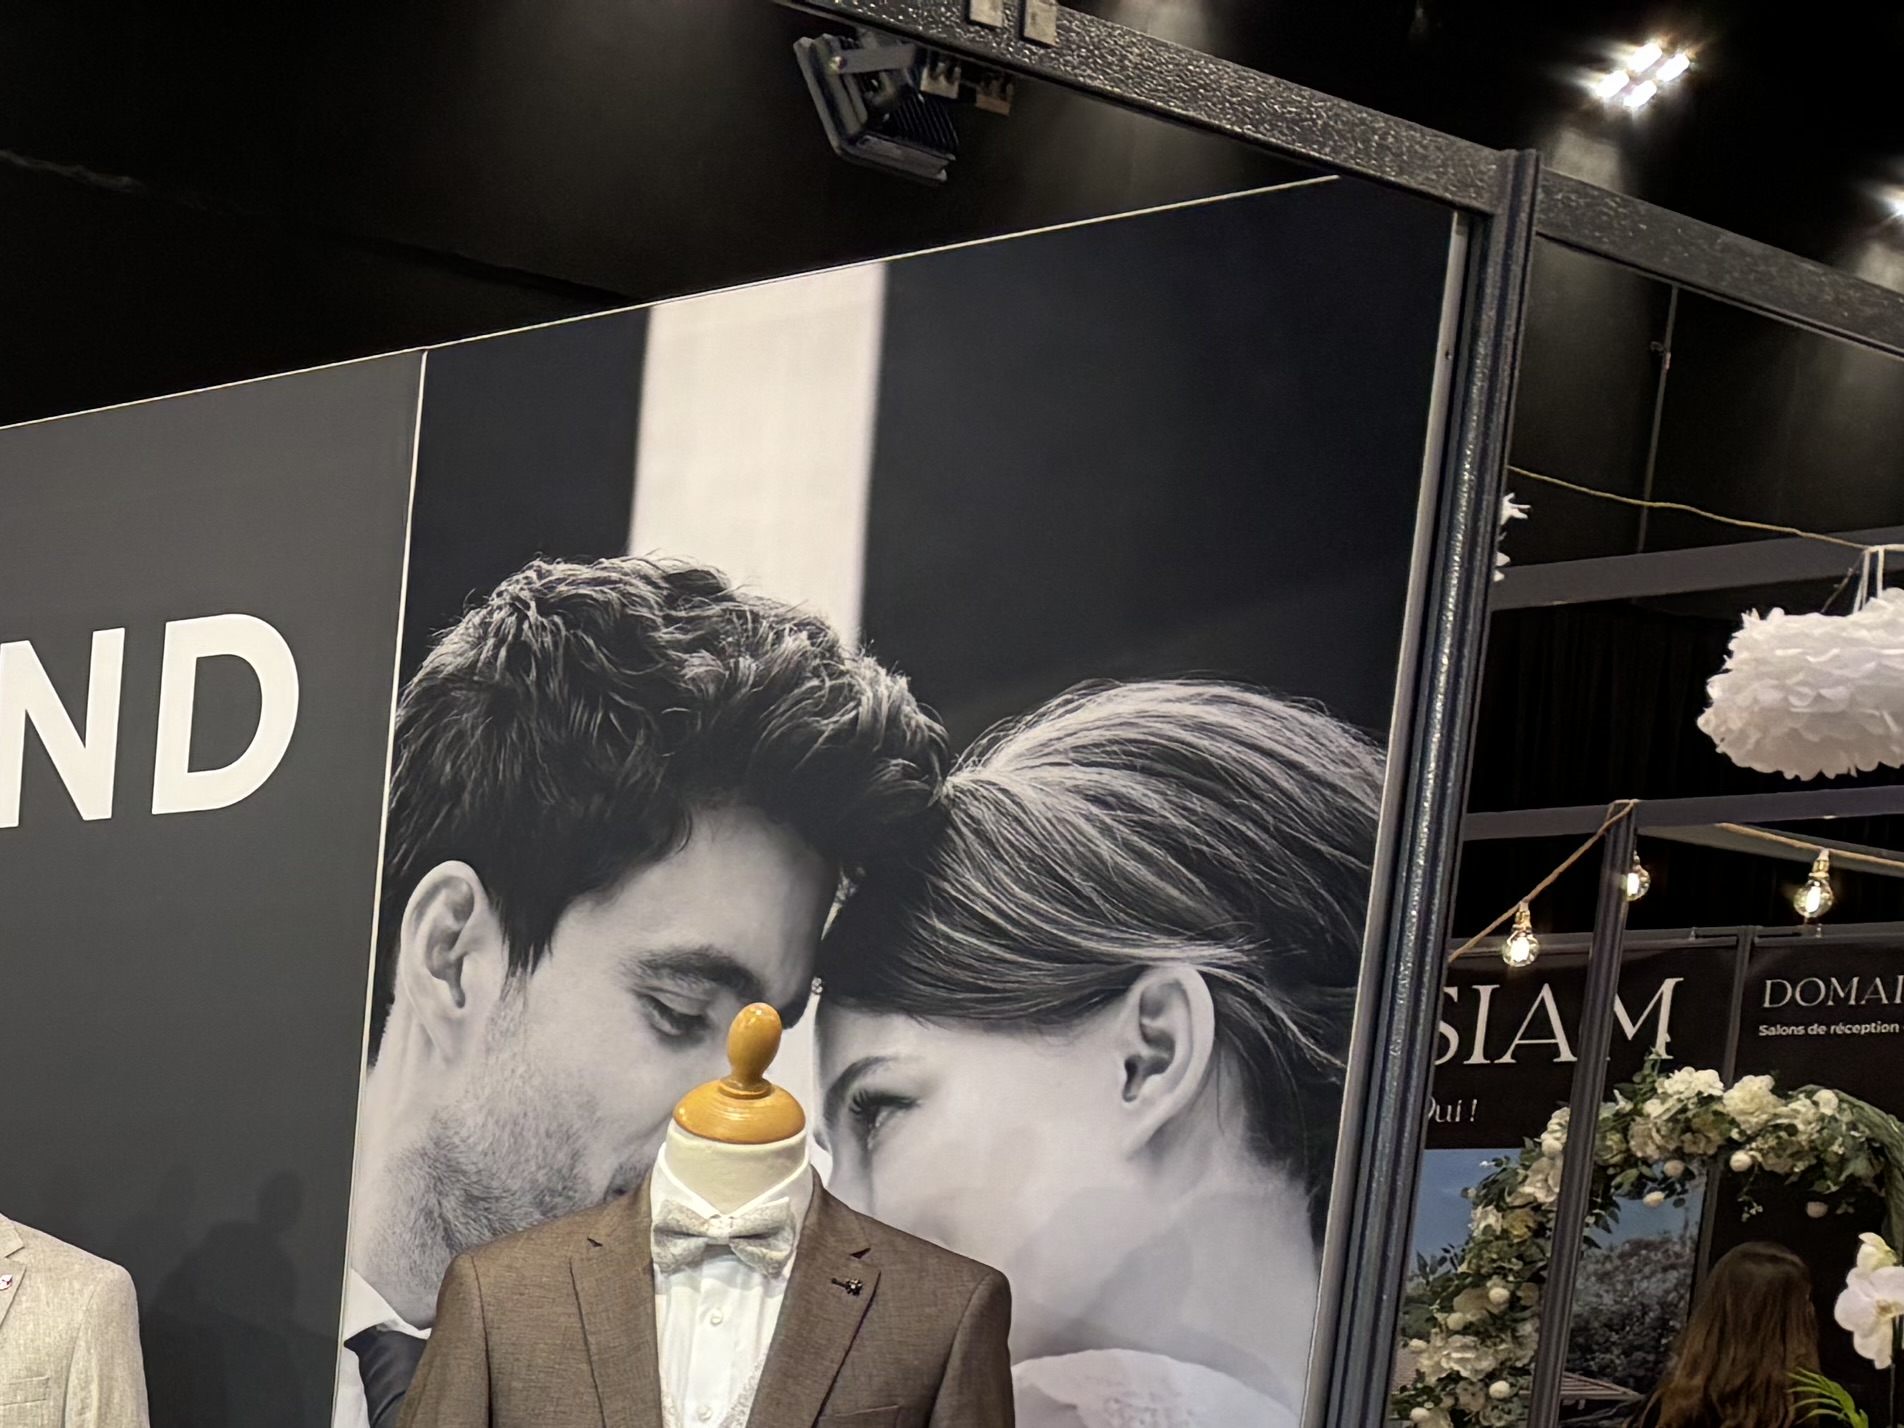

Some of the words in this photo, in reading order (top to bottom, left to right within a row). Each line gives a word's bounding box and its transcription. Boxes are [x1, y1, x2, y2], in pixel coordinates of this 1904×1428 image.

[1758, 1024, 1806, 1037] Salons
[1807, 1023, 1828, 1036] de
[1830, 1021, 1900, 1036] réception
[1428, 1096, 1463, 1123] ui
